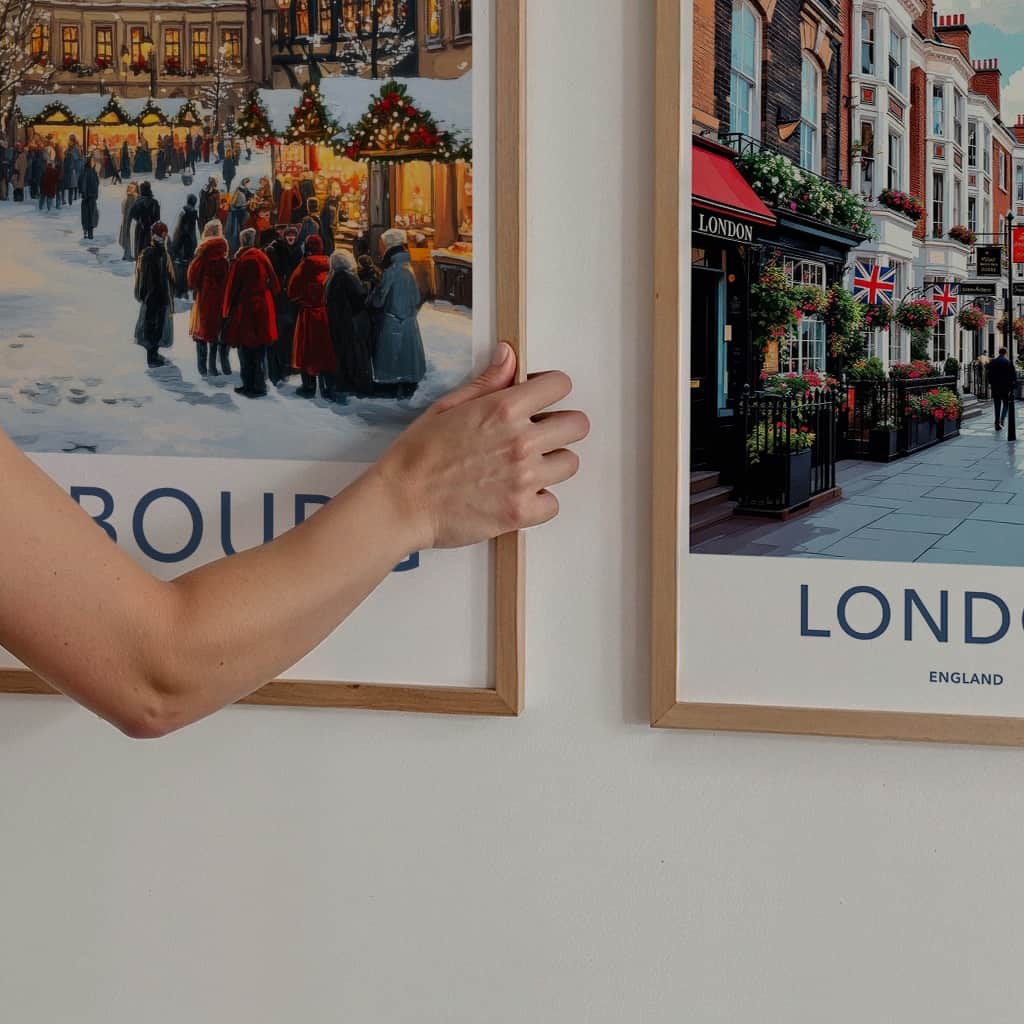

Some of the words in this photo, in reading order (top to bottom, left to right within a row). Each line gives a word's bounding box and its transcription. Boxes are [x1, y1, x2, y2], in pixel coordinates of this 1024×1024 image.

[698, 213, 753, 242] LONDON
[800, 584, 1024, 645] LOND
[929, 671, 1004, 686] ENGLAND
